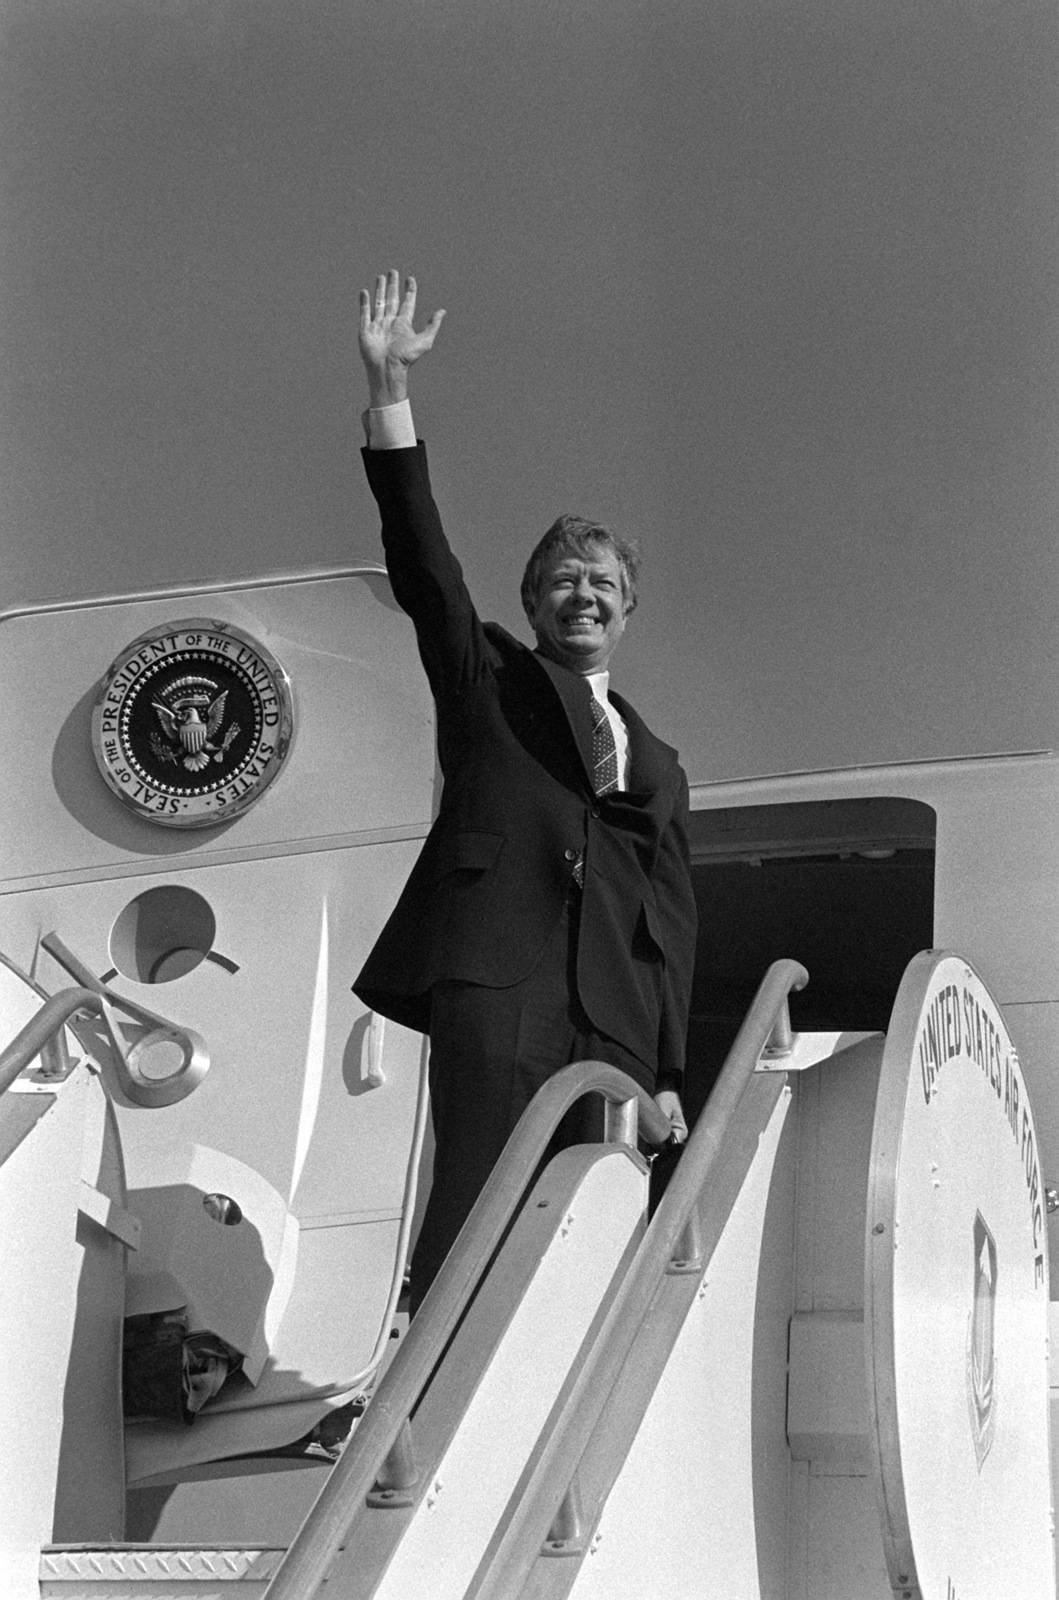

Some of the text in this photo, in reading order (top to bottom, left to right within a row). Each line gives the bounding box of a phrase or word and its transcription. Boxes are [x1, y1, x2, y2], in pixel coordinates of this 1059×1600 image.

[103, 634, 279, 813] SEAL OF THE PRESIDENT OF THE UNITED STATES
[919, 984, 962, 1106] UNITED
[963, 986, 1002, 1100] STATES
